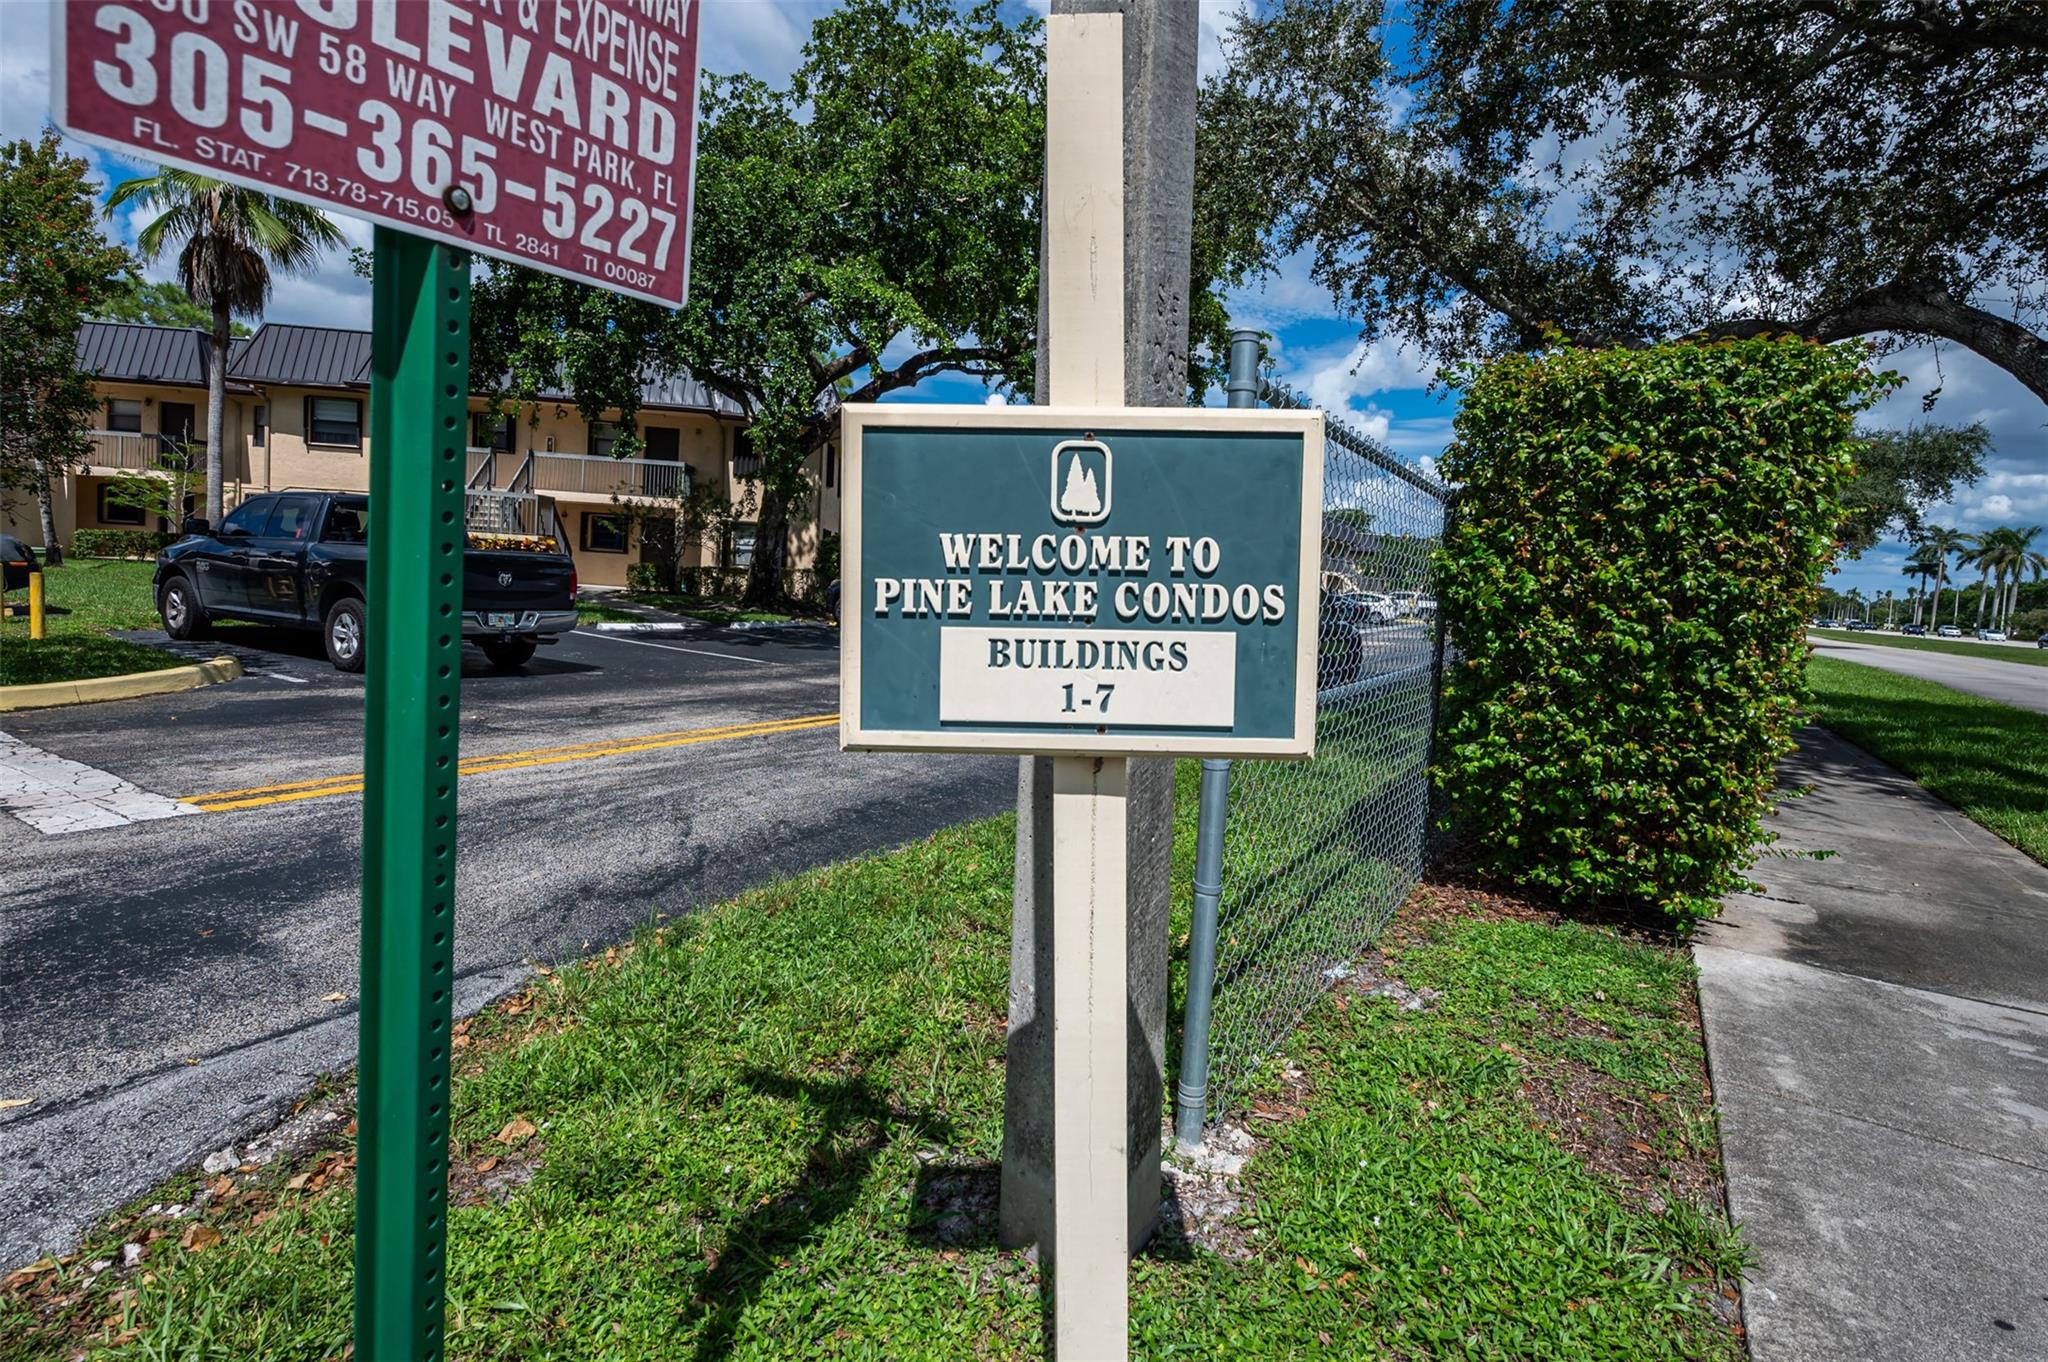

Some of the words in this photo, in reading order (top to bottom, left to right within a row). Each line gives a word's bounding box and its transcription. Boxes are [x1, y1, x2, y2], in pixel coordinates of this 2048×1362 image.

[628, 0, 692, 37] WAY
[555, 0, 680, 102] EXPENSE
[233, 0, 299, 58] SW
[319, 32, 366, 85] 58
[386, 58, 456, 118] WAY
[484, 98, 562, 160] WEST
[573, 137, 642, 194] PARK,
[653, 171, 677, 207] FL
[94, 4, 677, 272] 305-365-5227
[133, 116, 179, 149] FL.
[195, 136, 273, 177] STAT.
[284, 162, 455, 229] 713.78-715.05
[484, 222, 507, 246] TL
[515, 233, 559, 261] 2841
[604, 261, 656, 289] 00087
[939, 533, 1151, 572] WELCOME
[1166, 537, 1221, 574] TO
[874, 578, 972, 615] PINE
[988, 580, 1098, 617] LAKE
[1114, 582, 1286, 621] CONDOS
[987, 638, 1189, 672] BUILDINGS
[1061, 683, 1116, 713] 1-7
